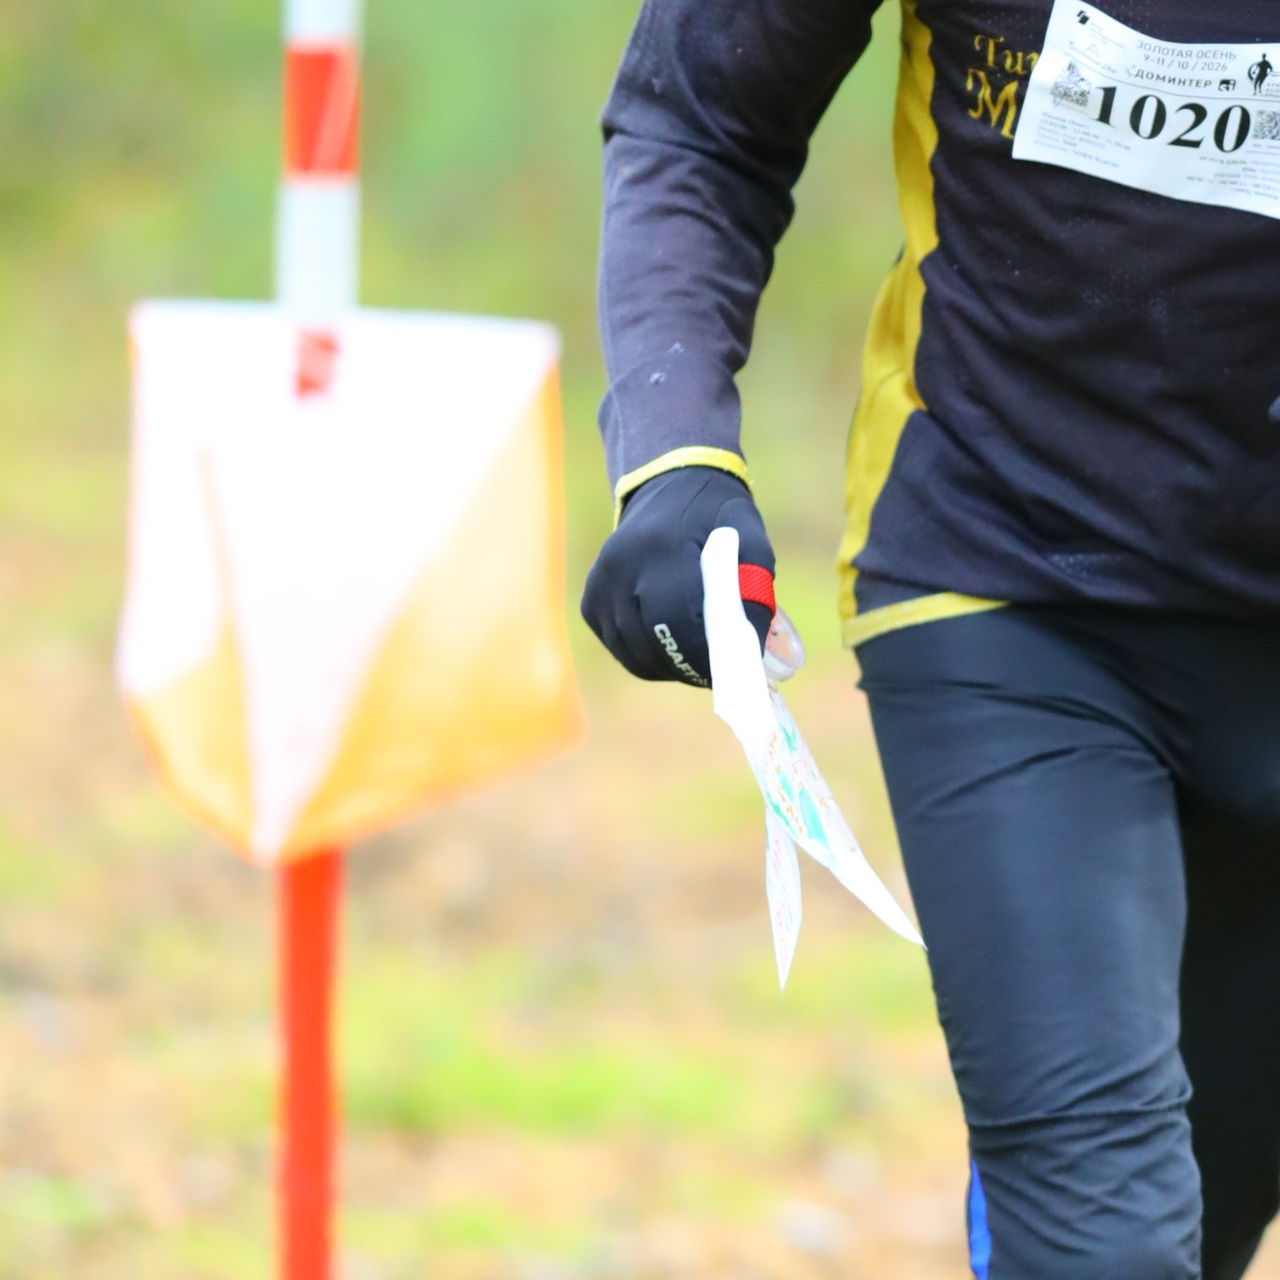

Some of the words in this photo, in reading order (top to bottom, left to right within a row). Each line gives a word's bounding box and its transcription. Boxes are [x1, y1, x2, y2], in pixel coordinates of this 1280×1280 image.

[1136, 40, 1192, 59] ЗОЛОТАЯ
[1196, 49, 1237, 61] ОСЕНЬ
[1177, 60, 1189, 70] 10
[1200, 61, 1228, 72] 2026
[1134, 68, 1213, 88] ДОМИНТЕР
[1092, 85, 1252, 153] 1020
[653, 622, 700, 677] CRAFT
